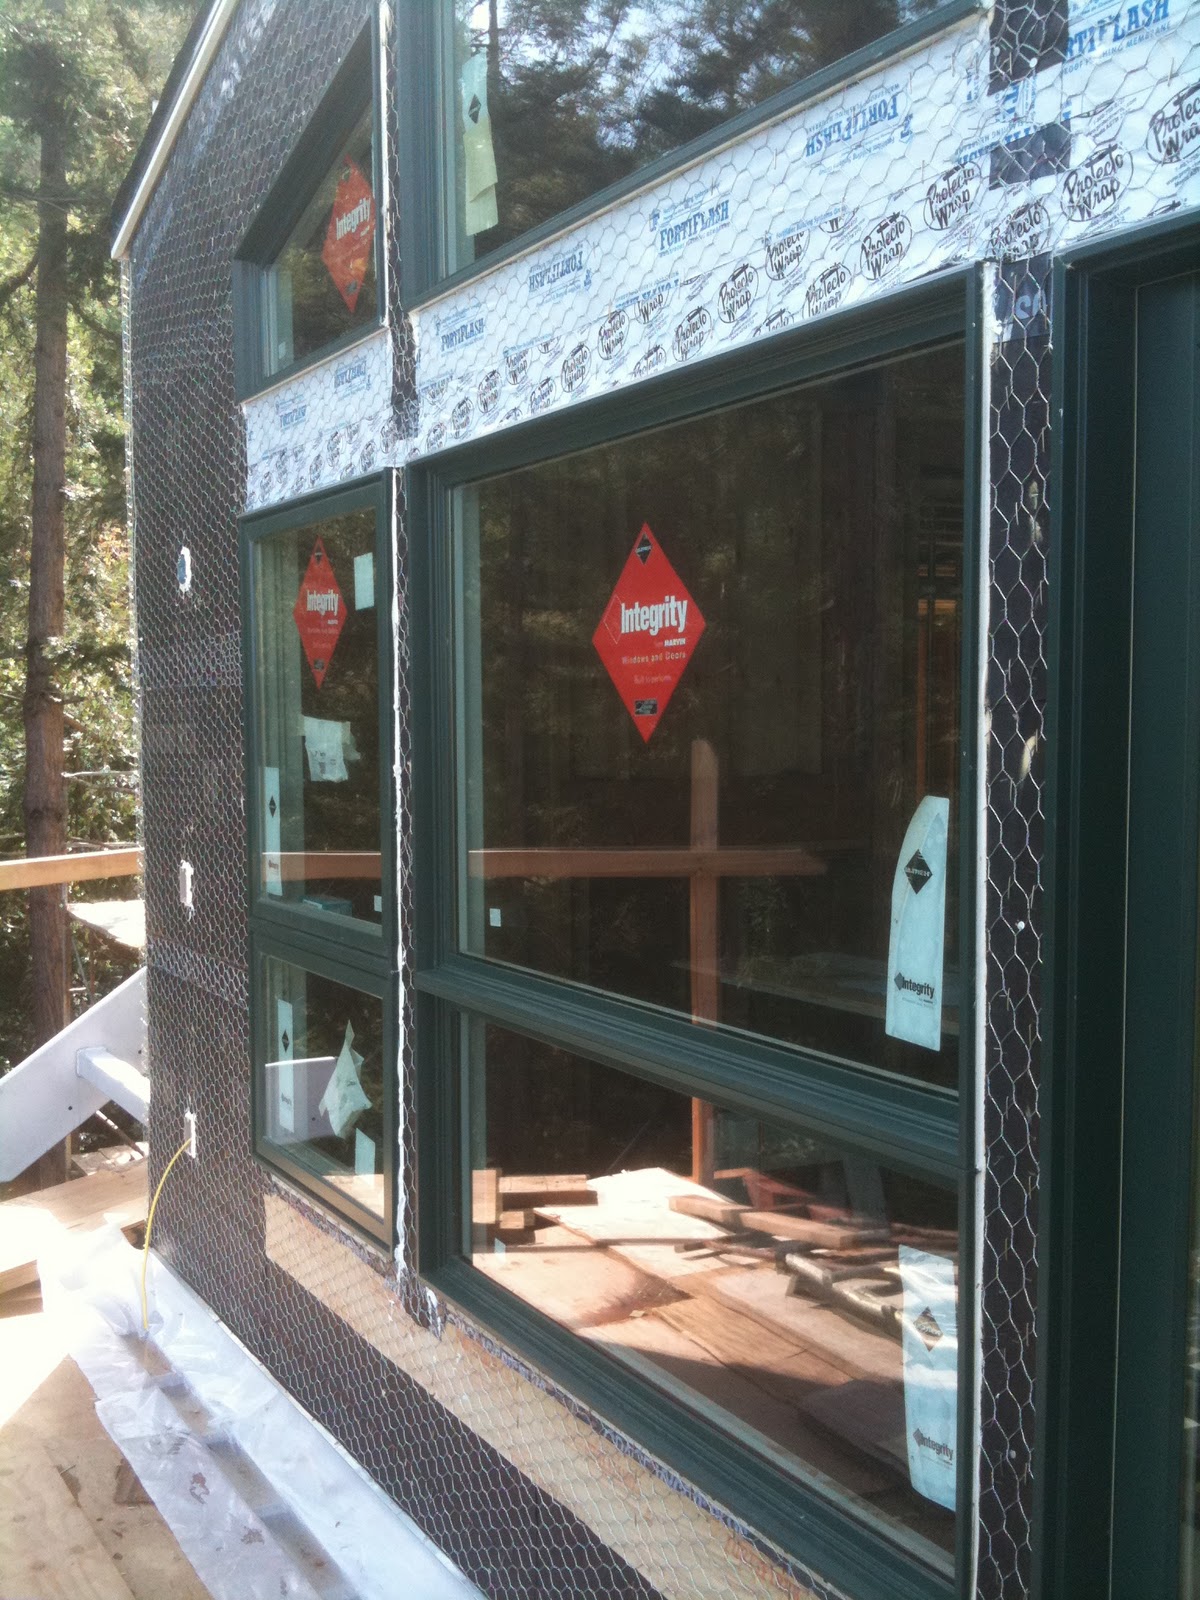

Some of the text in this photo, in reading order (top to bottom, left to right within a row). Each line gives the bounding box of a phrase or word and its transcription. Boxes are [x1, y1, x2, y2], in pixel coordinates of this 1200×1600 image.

[336, 197, 371, 241] Integrity
[660, 199, 730, 251] FORTIFLASH
[306, 588, 339, 616] Integrity
[621, 595, 688, 636] Integrity
[902, 976, 935, 1000] Integrity
[920, 1433, 954, 1461] Integrity
